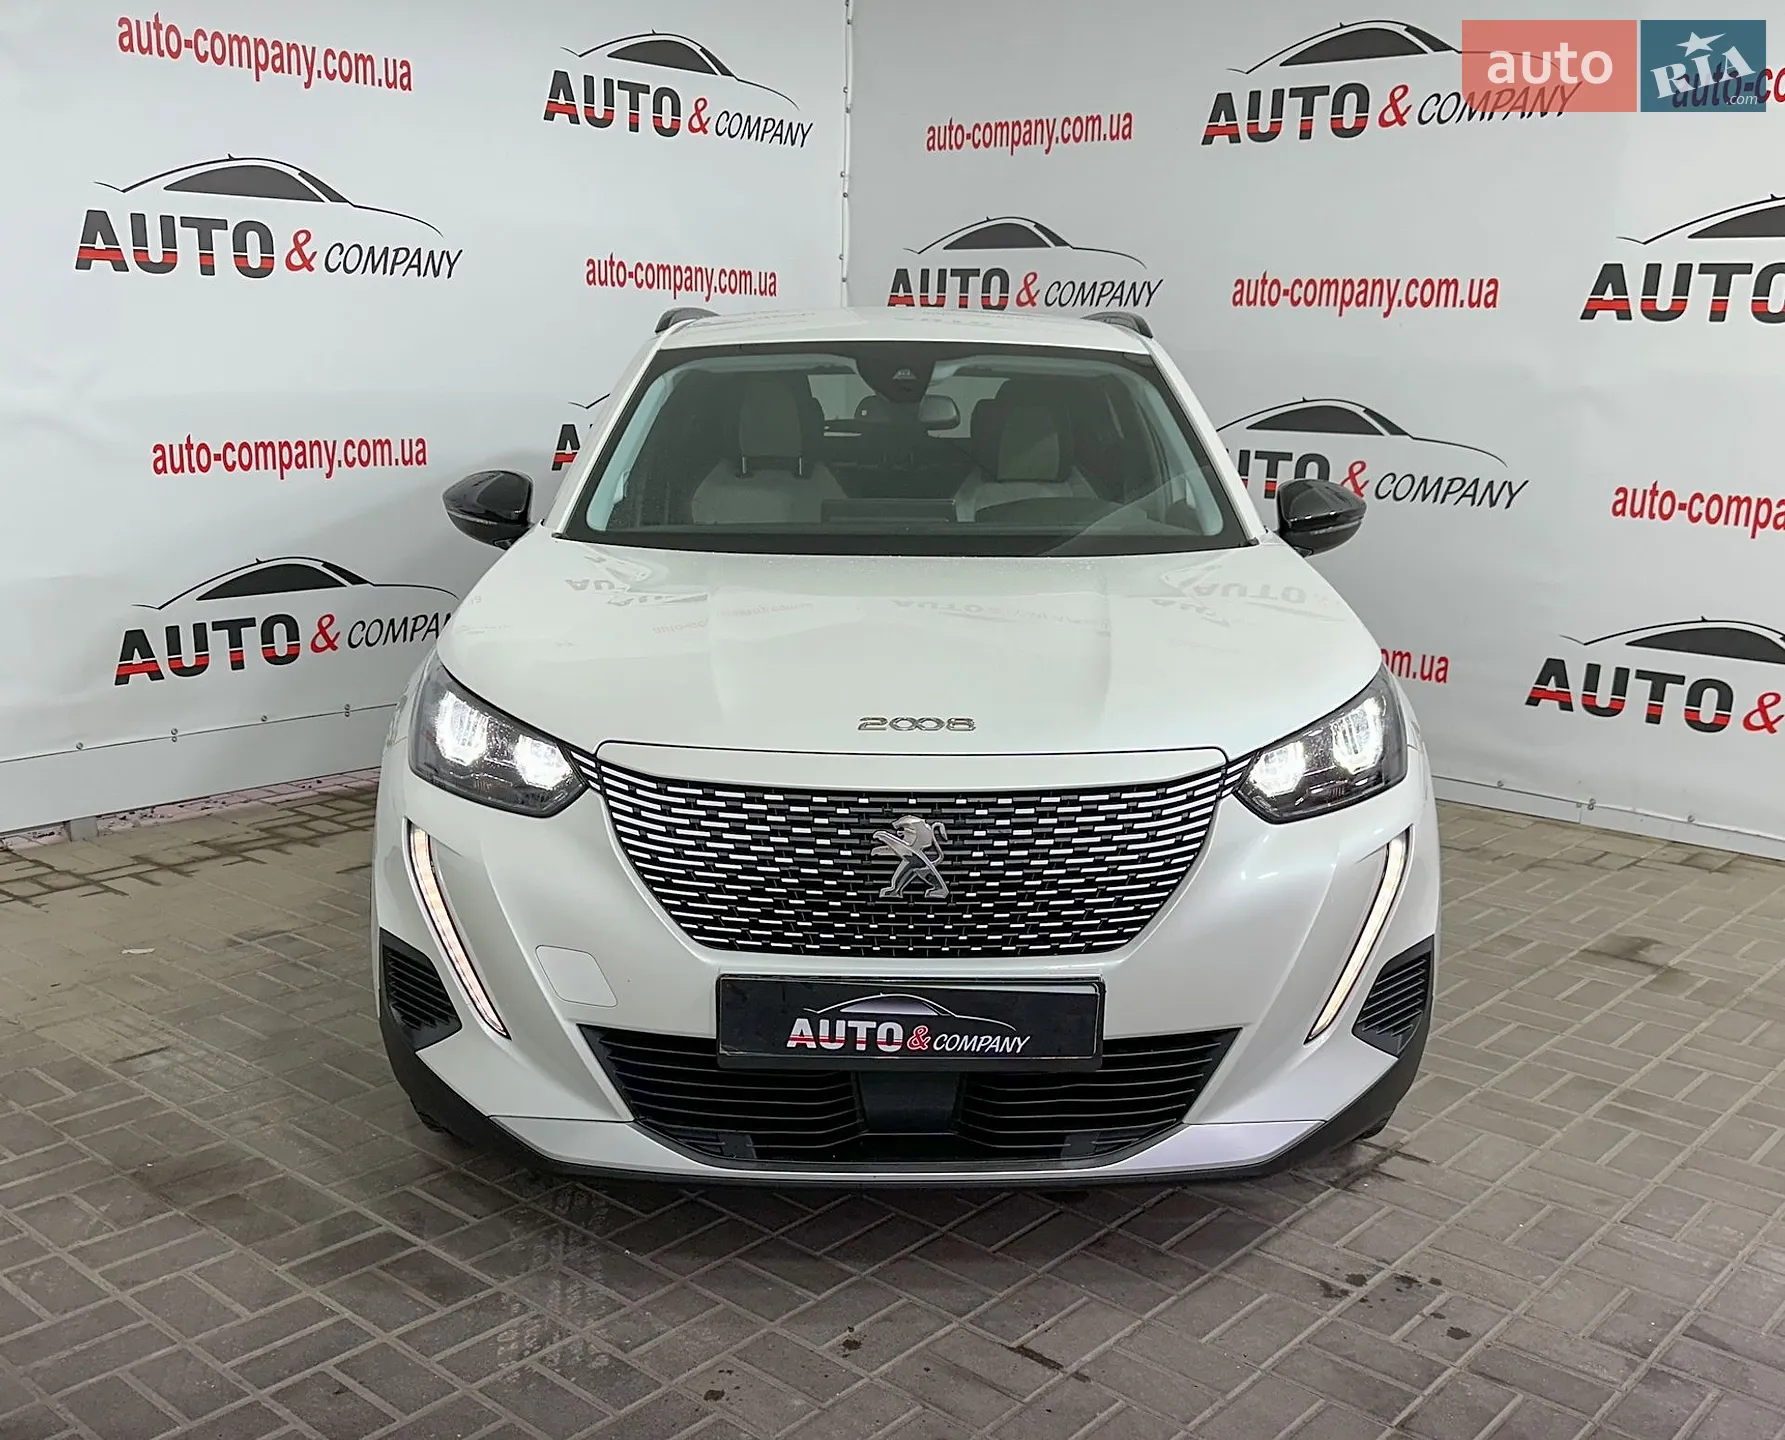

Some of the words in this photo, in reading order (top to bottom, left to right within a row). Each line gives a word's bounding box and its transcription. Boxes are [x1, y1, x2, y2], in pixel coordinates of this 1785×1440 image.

[117, 13, 413, 92] auto-company.com.ua
[543, 69, 682, 138] AUTO
[687, 97, 710, 136] &
[714, 110, 814, 149] COMPANY
[926, 111, 1133, 156] auto-company.com.ua
[1201, 82, 1371, 146] AUTO
[1377, 84, 1412, 129] &
[1417, 80, 1583, 126] COMPANY
[75, 209, 275, 279] AUTO
[284, 229, 318, 273] &
[323, 242, 464, 280] COMPANY
[585, 252, 778, 303] auto-company.com.ua
[887, 267, 1010, 310] AUTO
[1015, 272, 1043, 308] &
[1045, 278, 1165, 310] COMPANY
[1232, 270, 1499, 319] auto-company.com.ua
[1580, 263, 1785, 325] AUTO
[152, 433, 428, 480] auto-company.com.ua
[1340, 460, 1370, 498] &
[1374, 472, 1530, 510] COMPANY
[114, 613, 301, 686] AUTO
[309, 613, 340, 654] &
[347, 611, 452, 649] COMPA
[1525, 657, 1734, 734] AUTO
[1742, 691, 1783, 734] &
[857, 716, 976, 731] 2008
[786, 1018, 904, 1052] AUTO
[907, 1025, 929, 1051] &
[933, 1034, 1031, 1054] COMPANY
